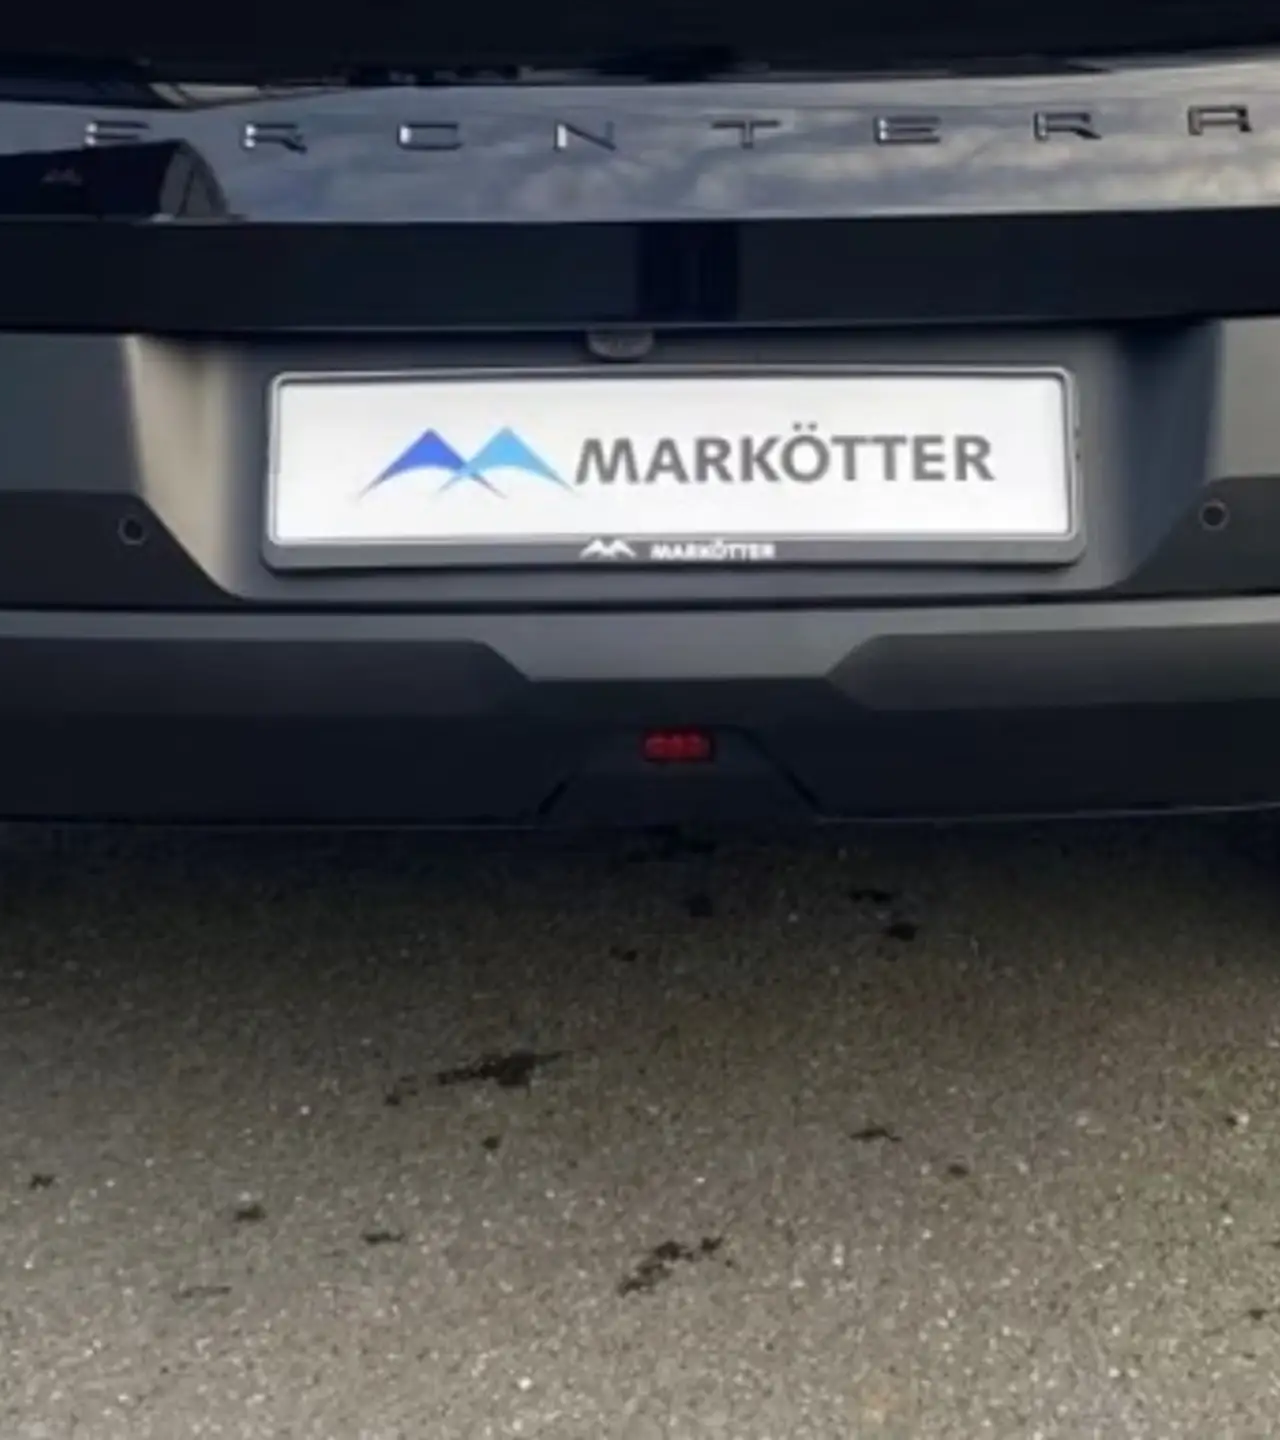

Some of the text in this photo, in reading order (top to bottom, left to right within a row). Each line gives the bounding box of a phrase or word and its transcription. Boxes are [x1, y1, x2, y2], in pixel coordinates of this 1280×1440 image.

[84, 104, 1252, 153] FRONTERA
[574, 422, 996, 485] MARKÖTTER
[650, 539, 777, 560] MARKÖTTER
